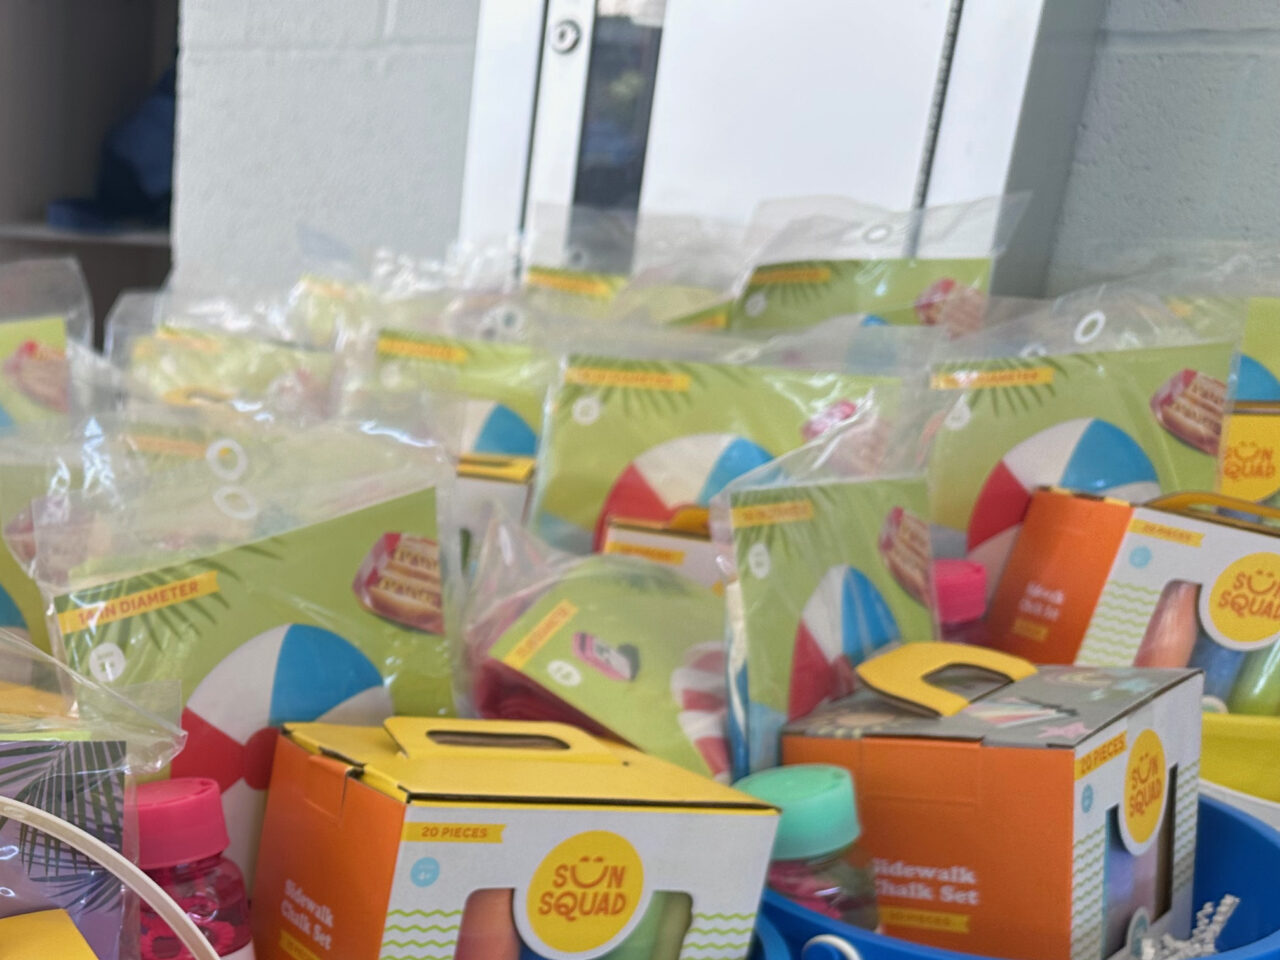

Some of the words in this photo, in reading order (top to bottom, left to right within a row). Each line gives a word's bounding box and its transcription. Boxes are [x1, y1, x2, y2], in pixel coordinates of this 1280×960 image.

[120, 581, 200, 613] DIAMETER
[1131, 752, 1159, 791] SUN
[1128, 777, 1162, 818] SQUAD
[421, 826, 438, 839] 20
[441, 827, 488, 839] PIECES
[553, 856, 627, 889] SUN
[538, 891, 627, 922] SQUAD
[939, 884, 980, 906] Set
